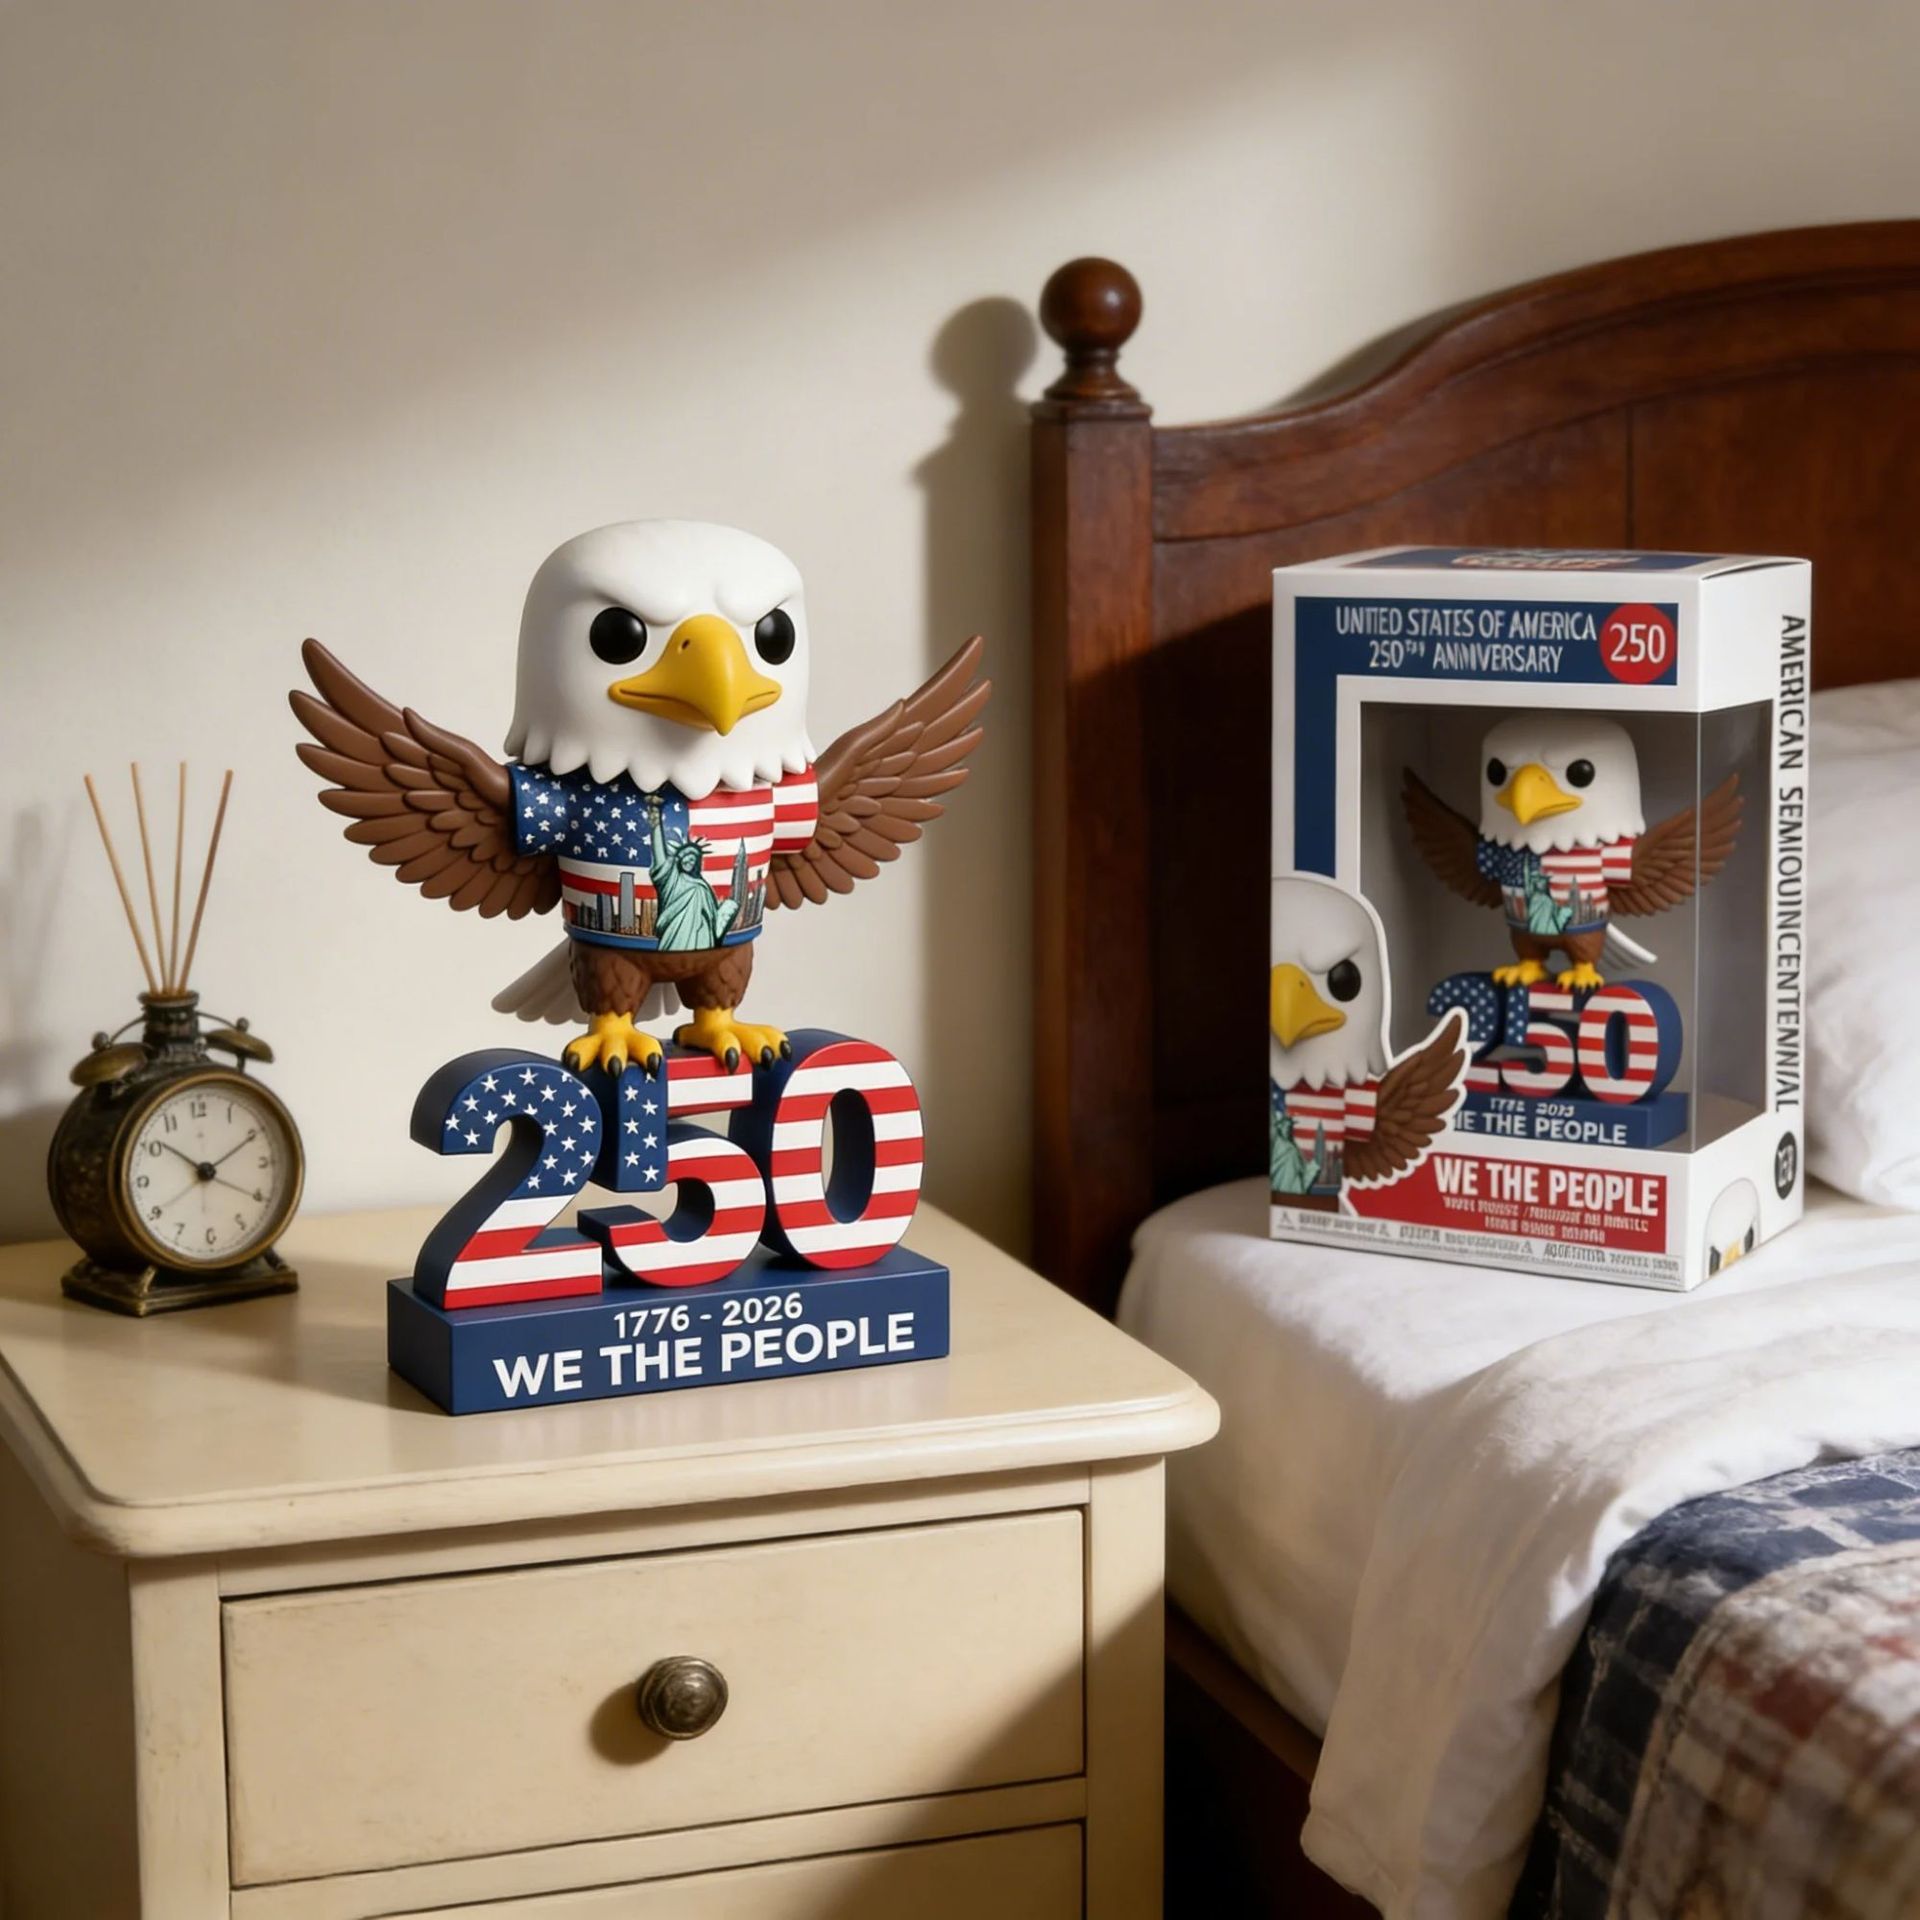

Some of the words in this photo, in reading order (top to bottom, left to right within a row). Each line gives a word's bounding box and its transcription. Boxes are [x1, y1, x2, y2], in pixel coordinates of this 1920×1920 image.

[1406, 608, 1474, 638] STATES
[1478, 610, 1505, 639] OF
[1508, 611, 1598, 642] AMERICA
[1609, 622, 1667, 664] 250
[1778, 614, 1807, 771] AMERICAN
[1428, 972, 1683, 1105] 250
[1482, 1112, 1527, 1137] THE
[1535, 1117, 1628, 1145] PEOPLE
[410, 1028, 925, 1309] 250
[1433, 1155, 1480, 1196] WE
[1485, 1162, 1540, 1203] THE
[1548, 1169, 1659, 1217] PEOPLE
[612, 1304, 690, 1339] 1776
[721, 1291, 803, 1327] 2026
[492, 1349, 584, 1399] WE
[599, 1336, 703, 1386] THE
[720, 1311, 915, 1373] PEOPLE
